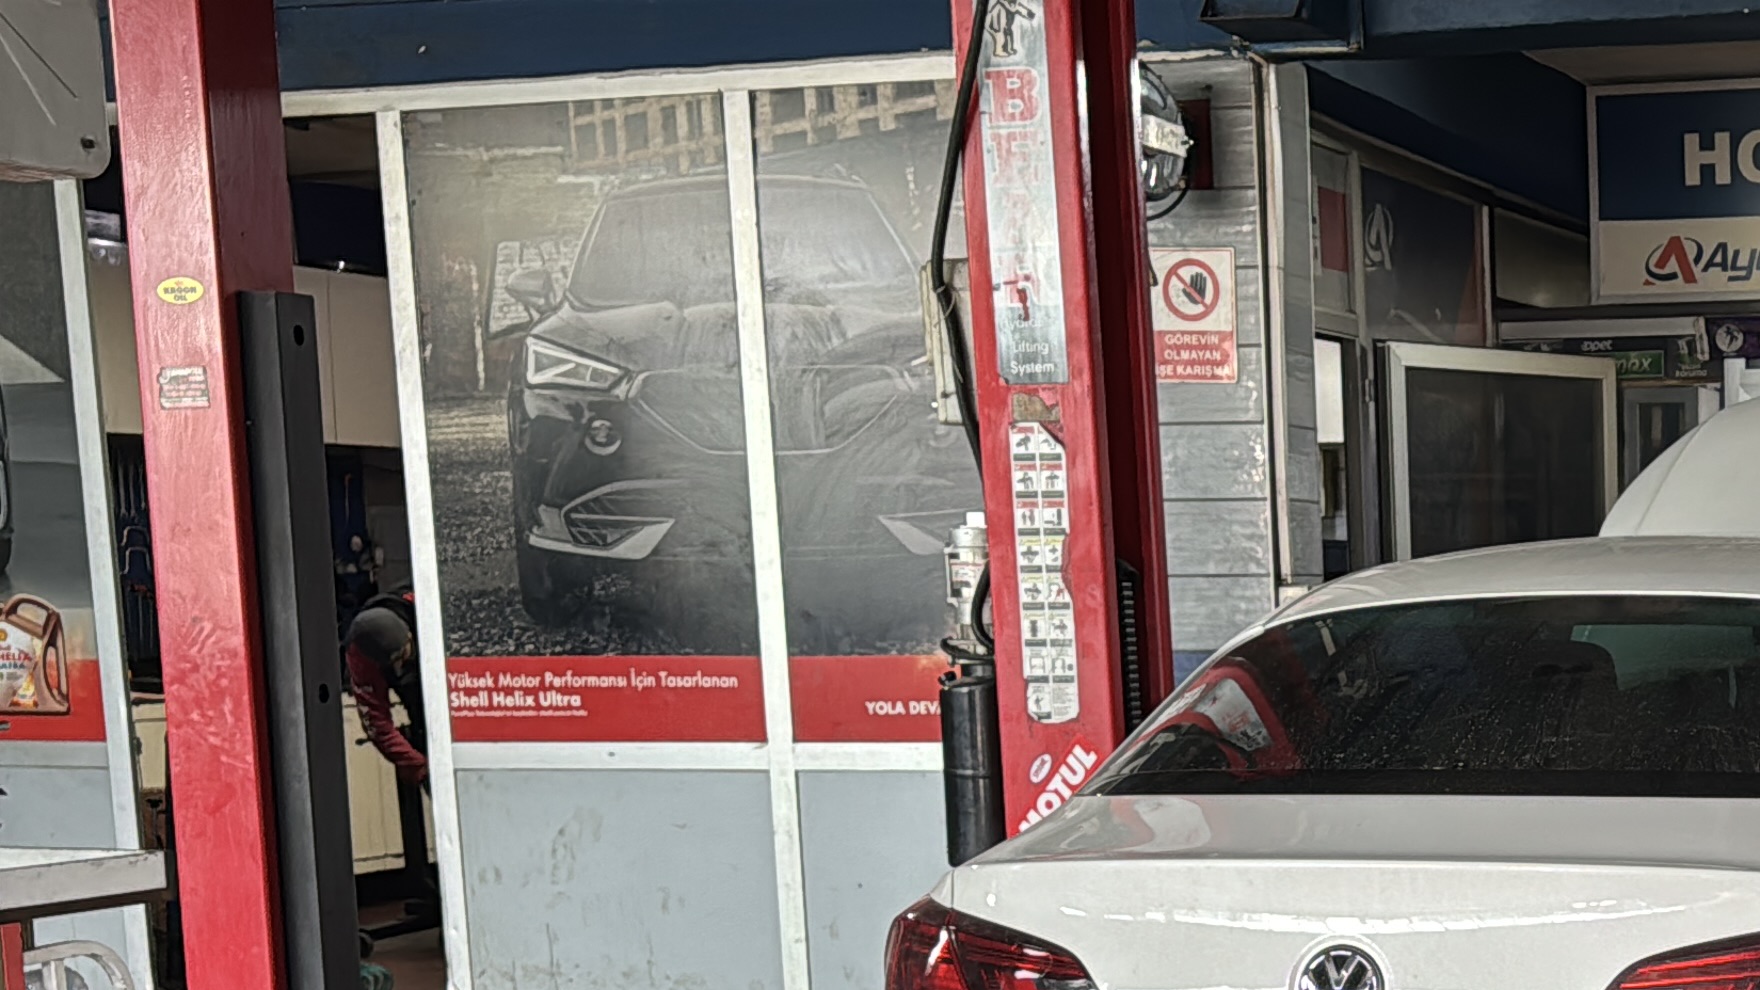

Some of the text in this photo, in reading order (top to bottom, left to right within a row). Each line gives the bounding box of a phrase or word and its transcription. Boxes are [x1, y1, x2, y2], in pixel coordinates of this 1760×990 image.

[1164, 332, 1219, 345] GÖREVİN
[1164, 349, 1222, 361] OLMAYAN
[1010, 360, 1054, 377] System
[448, 667, 739, 692] Yüksek Motor Performansı İçin Tasarlanan
[450, 690, 582, 707] Shell Helix Ultra
[864, 700, 906, 715] YOLA
